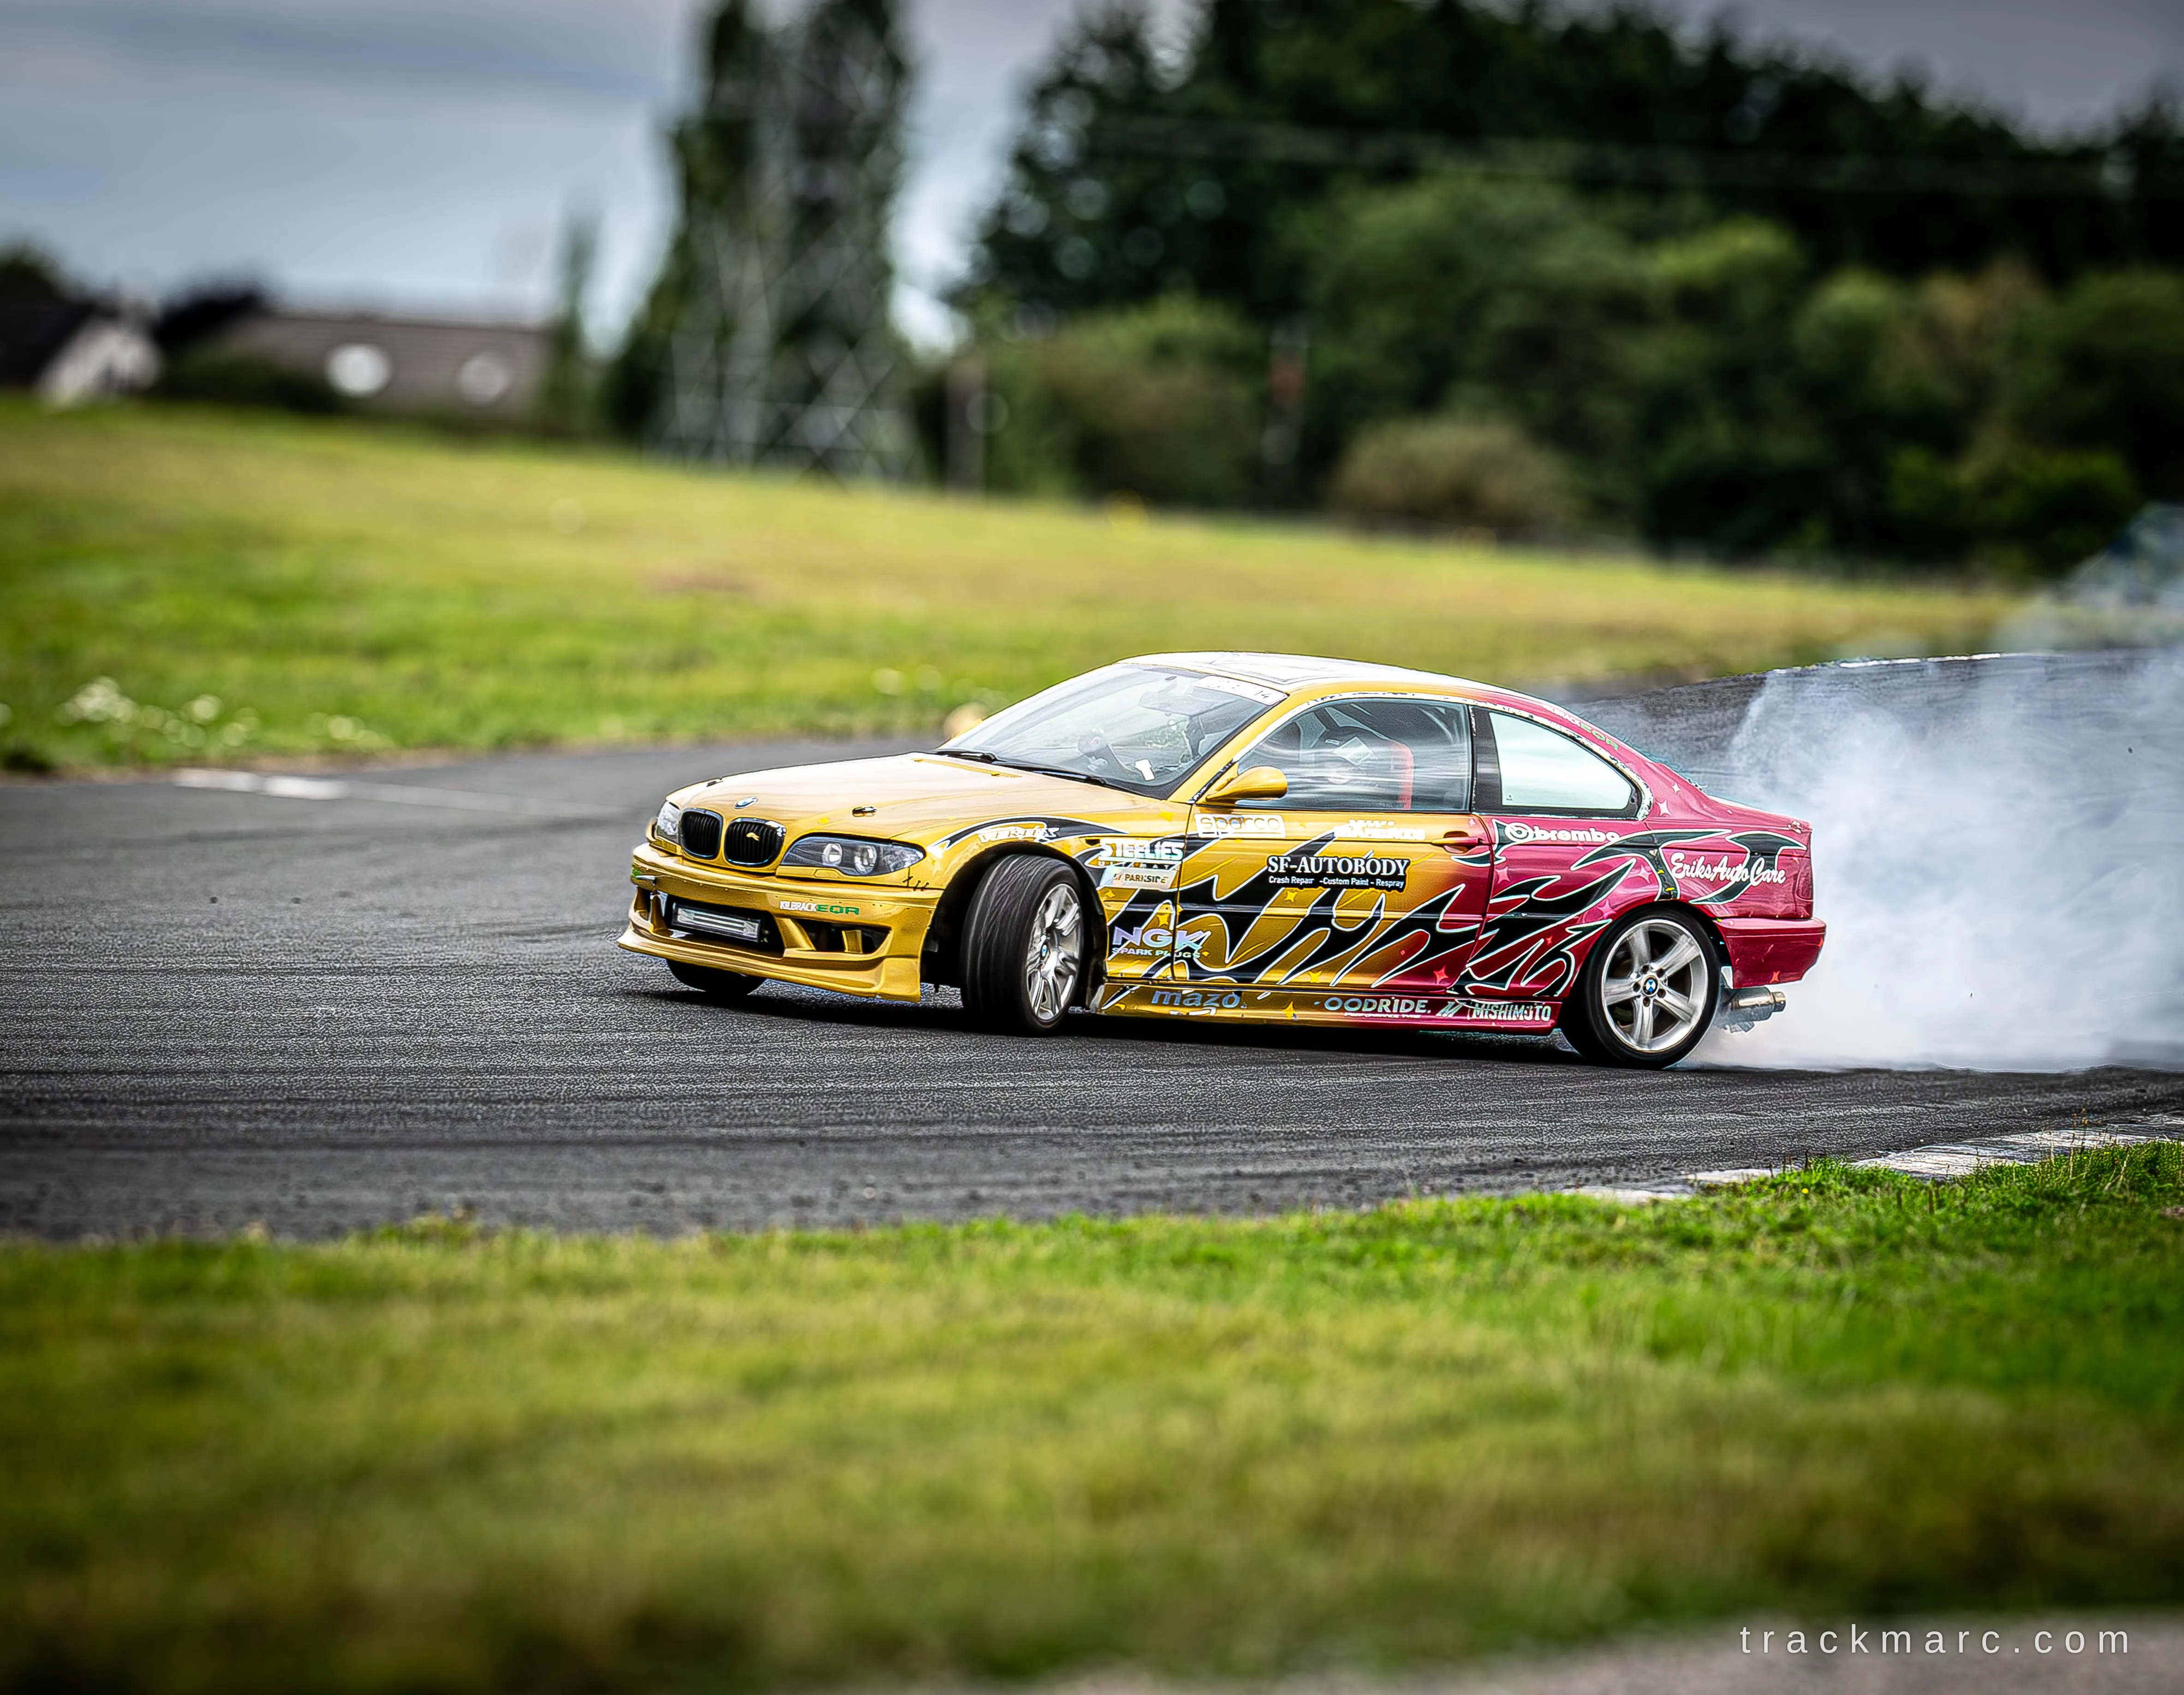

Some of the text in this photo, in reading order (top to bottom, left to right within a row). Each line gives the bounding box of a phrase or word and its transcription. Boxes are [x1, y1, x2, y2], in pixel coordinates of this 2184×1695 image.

[1200, 816, 1280, 830] sparco
[1533, 825, 1620, 843] brembo
[1268, 856, 1409, 876] SF-AUTOBODY
[1750, 857, 1786, 886] Care
[1291, 877, 1314, 886] Repair
[1376, 879, 1405, 889] Respray
[1112, 926, 1204, 950] NGK
[1112, 947, 1153, 956] SPARK
